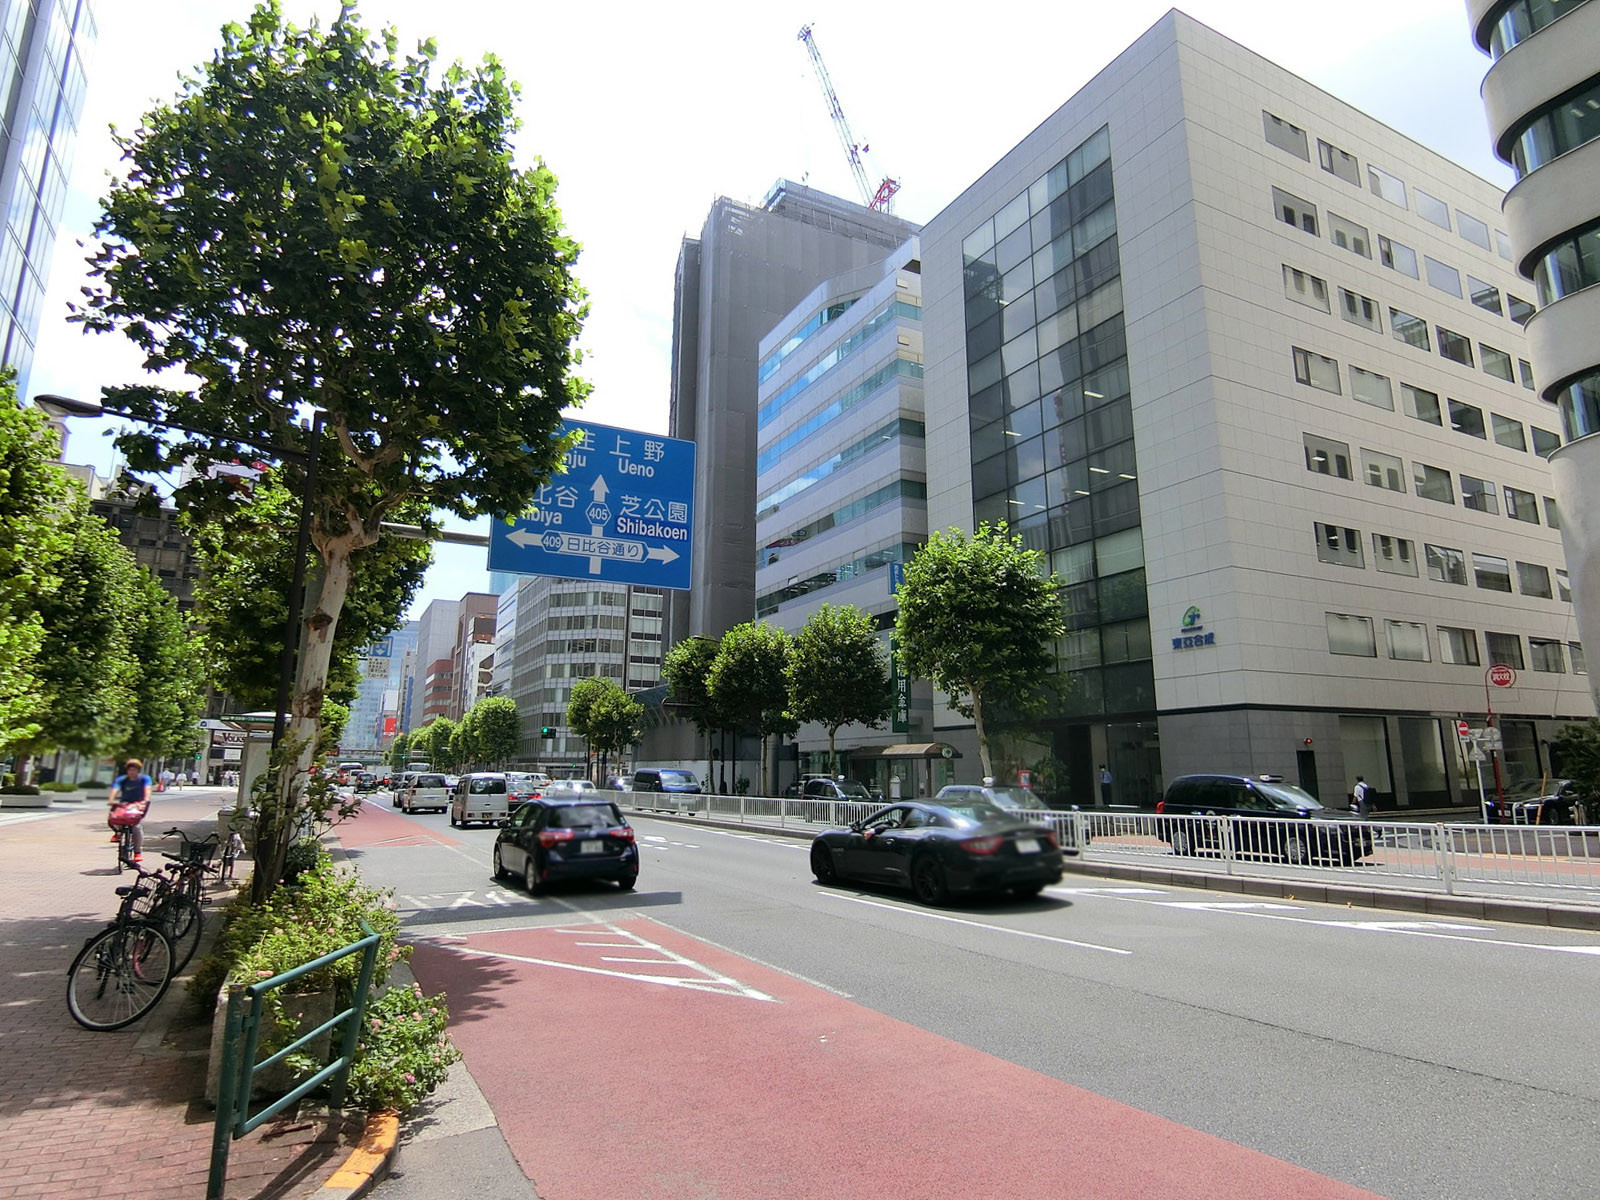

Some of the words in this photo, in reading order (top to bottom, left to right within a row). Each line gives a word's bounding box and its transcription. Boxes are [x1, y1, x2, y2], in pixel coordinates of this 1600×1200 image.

[609, 434, 665, 462] 上野
[618, 458, 655, 478] Ueno
[588, 507, 608, 521] 405
[620, 494, 688, 524] 芝公園
[616, 517, 688, 541] Shibakoen
[543, 535, 562, 548] 409
[567, 537, 640, 558] 日比谷通り
